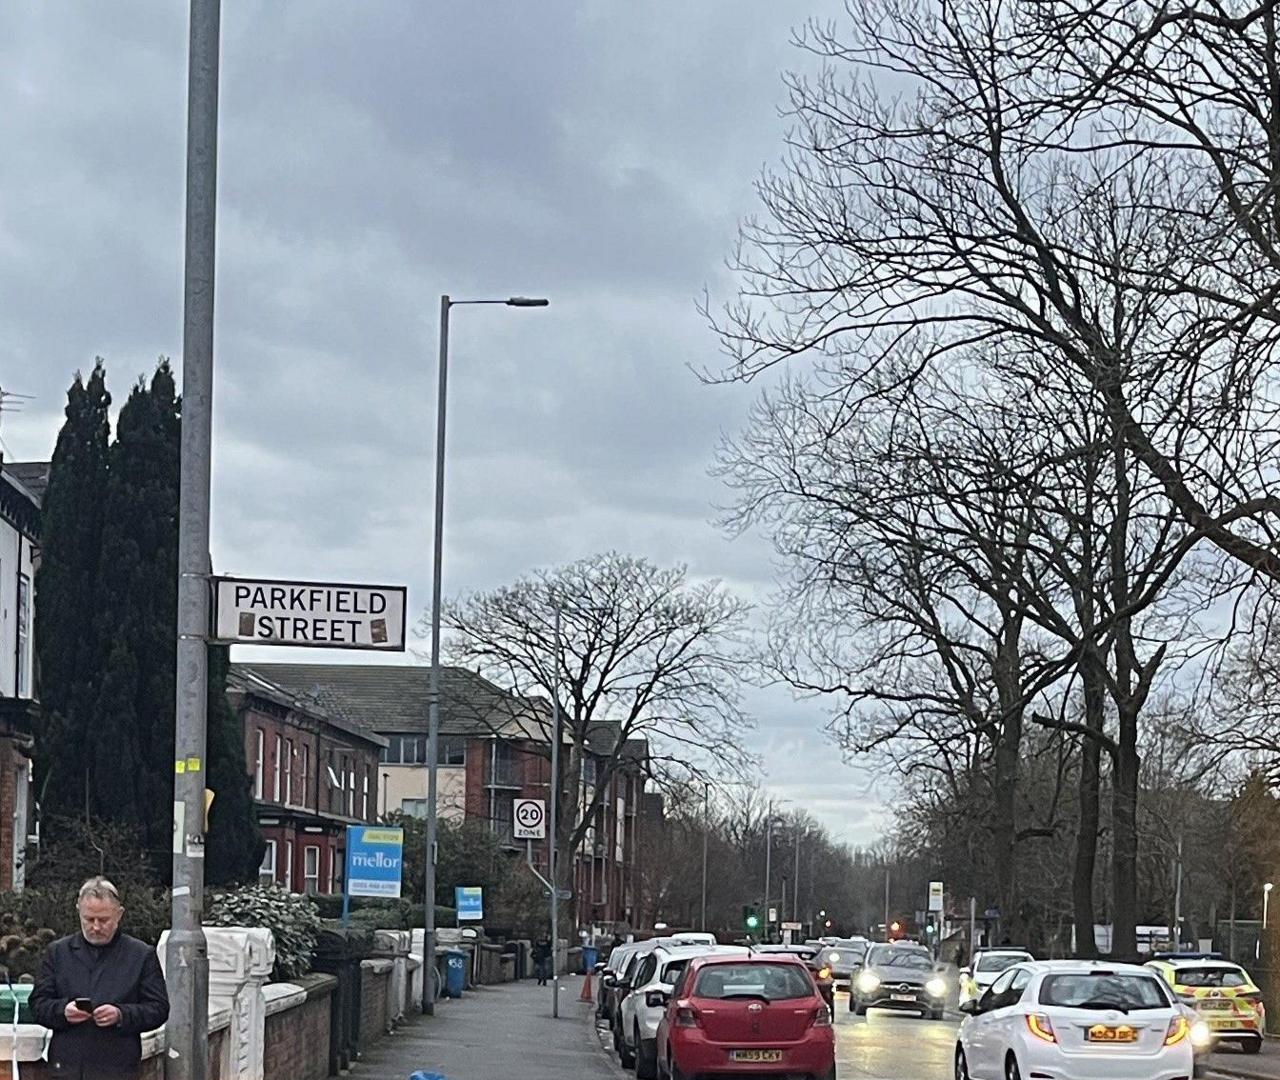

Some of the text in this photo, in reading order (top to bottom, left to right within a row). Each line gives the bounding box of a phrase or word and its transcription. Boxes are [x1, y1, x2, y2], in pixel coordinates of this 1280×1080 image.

[235, 586, 387, 614] PARKFIELD
[257, 615, 362, 643] STREET
[521, 809, 539, 820] 20
[352, 852, 400, 868] mellor
